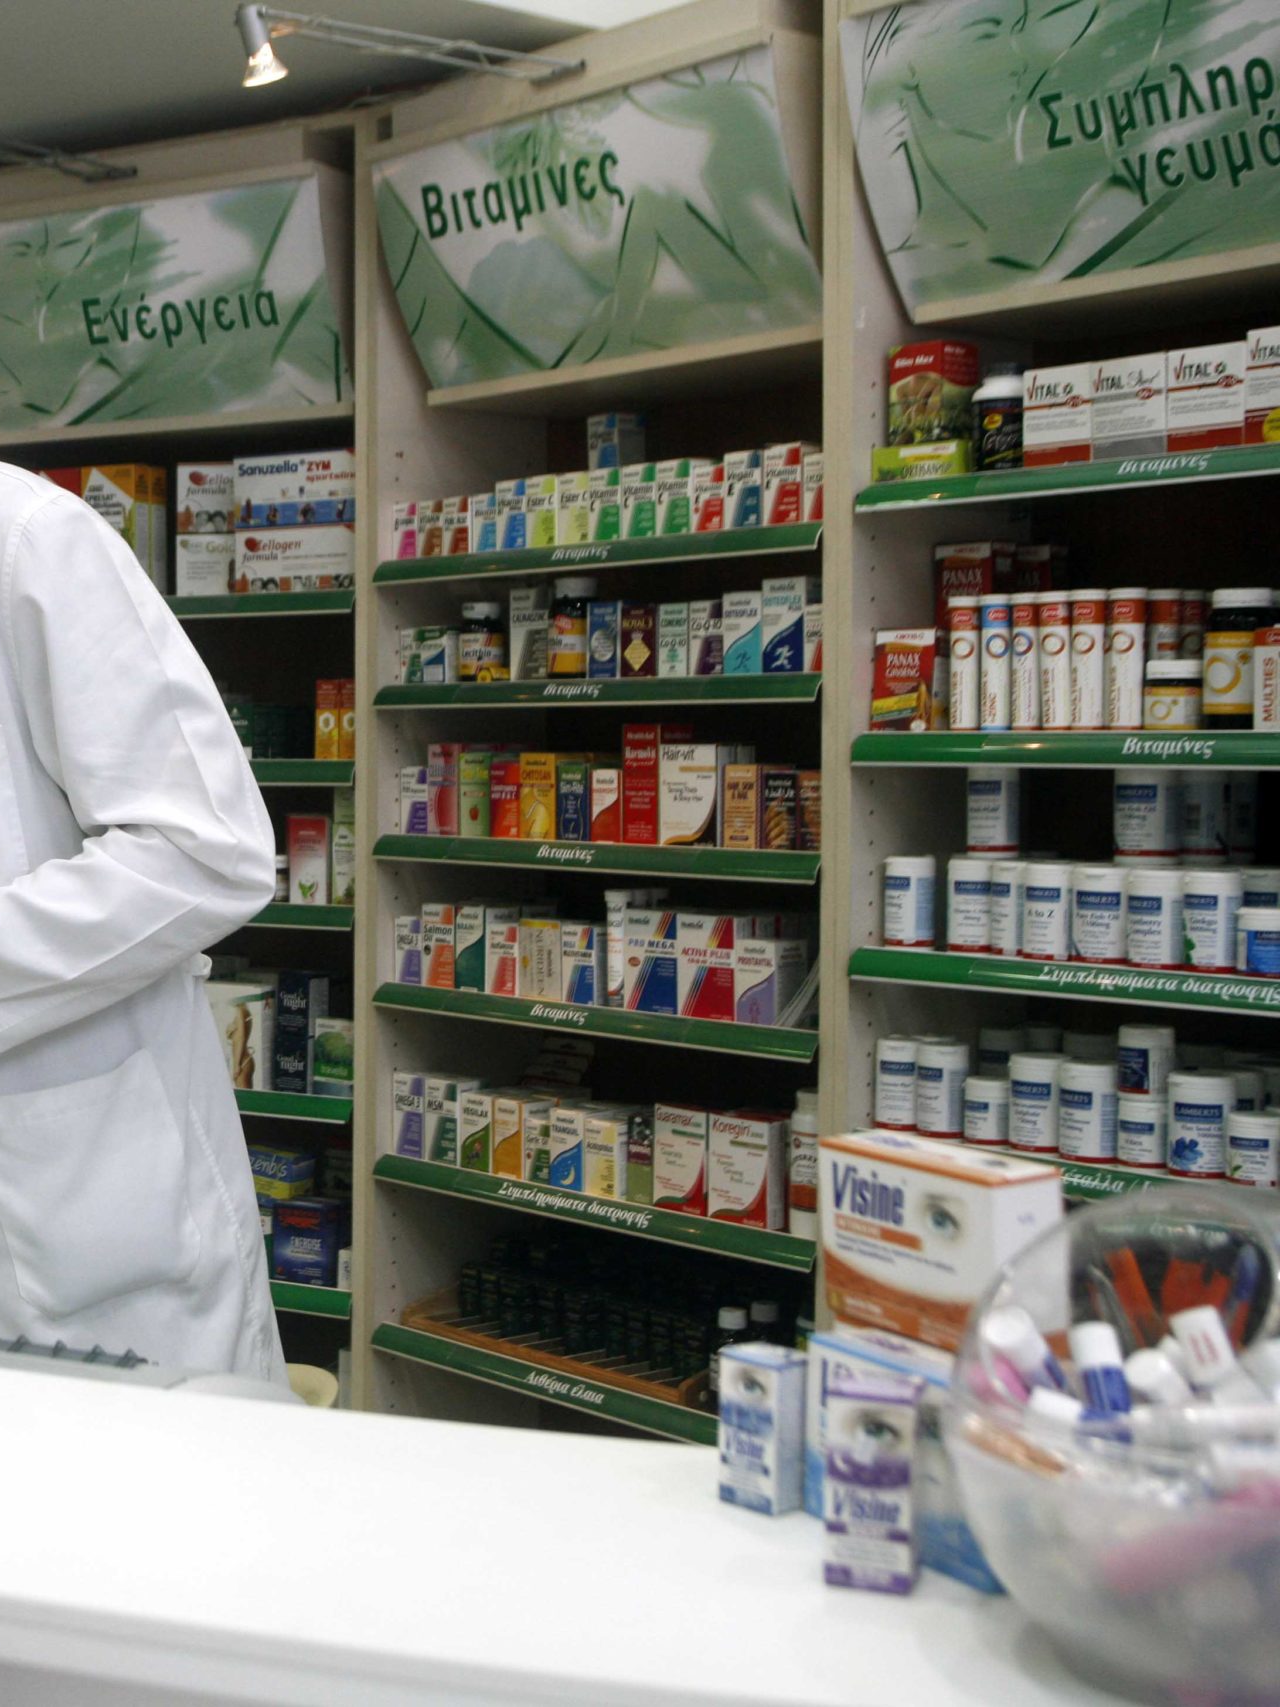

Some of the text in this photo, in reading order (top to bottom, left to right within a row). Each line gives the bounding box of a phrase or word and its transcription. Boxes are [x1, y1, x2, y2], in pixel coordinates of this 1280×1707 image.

[1039, 57, 1275, 148] Συμπληρ
[420, 148, 627, 240] Βιταμίνες
[82, 289, 280, 349] Ενέργεια
[1174, 353, 1211, 381] VITAL
[1093, 366, 1124, 392] VITAL
[238, 460, 331, 477] Sanuzella ZYM
[727, 469, 754, 482] Vegan
[766, 467, 798, 478] Vitamin
[589, 488, 619, 500] Vitamin
[623, 483, 653, 496] Vitamin
[657, 480, 689, 493] Vitamin
[243, 552, 279, 565] formula
[942, 568, 983, 586] PANAX
[887, 652, 920, 667] PANAX
[1263, 657, 1275, 722] MULTIES
[1121, 737, 1216, 760] Βιταμίνες
[536, 844, 595, 864] Βιταμίνες
[1078, 895, 1119, 905] LAMBERTS
[1047, 909, 1055, 919] Z
[423, 924, 452, 937] Salmon
[423, 934, 433, 943] Oil
[628, 938, 675, 950] PRO MEGA
[681, 948, 731, 960] ACTIVE PLUS
[1038, 966, 1280, 1005] Συμπληρώματα διατροφής
[283, 998, 306, 1010] night
[530, 1003, 589, 1026] Βιταμίνες
[280, 1061, 305, 1073] night
[427, 1098, 443, 1111] MSM
[1175, 1106, 1220, 1117] LAMBERTS
[1063, 1166, 1125, 1193] έταλλα
[832, 1160, 905, 1227] Visine
[498, 1181, 653, 1229] Συμπληρώματα διατροφής
[724, 1429, 765, 1460] Visine
[833, 1485, 901, 1524] Visine
